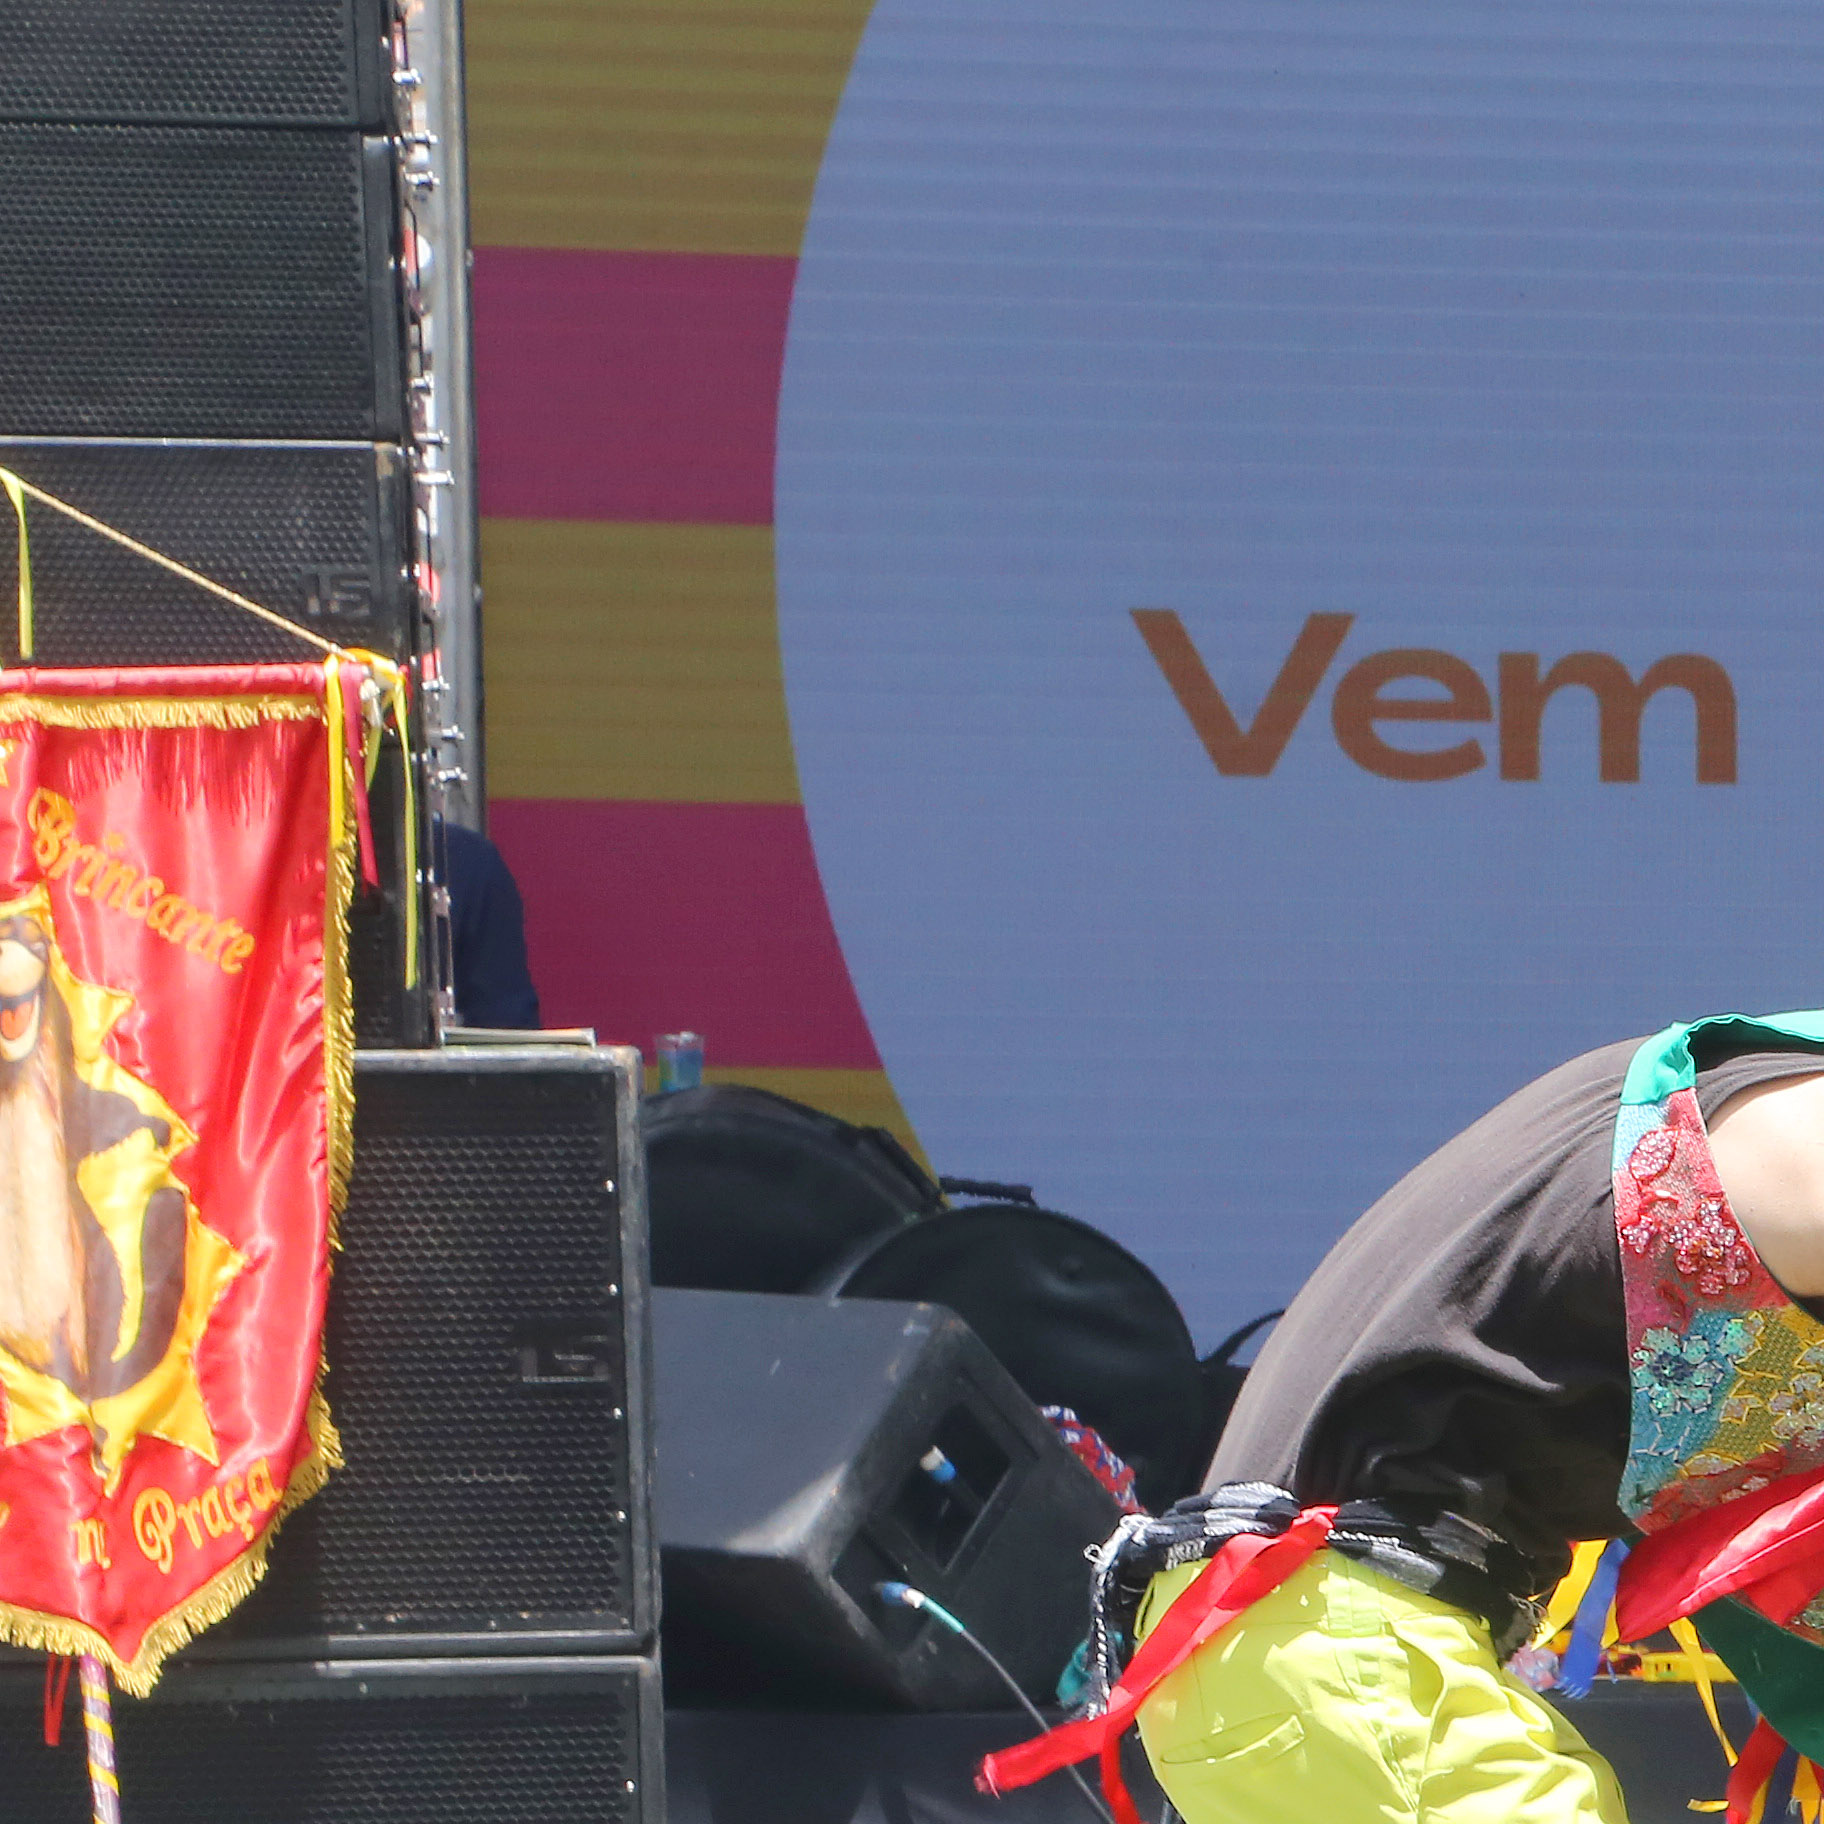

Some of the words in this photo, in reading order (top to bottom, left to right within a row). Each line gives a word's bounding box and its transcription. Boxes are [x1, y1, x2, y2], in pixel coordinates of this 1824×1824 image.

[1128, 608, 1738, 785] Vem
[27, 787, 255, 975] Brincante
[132, 1457, 284, 1575] Praça
